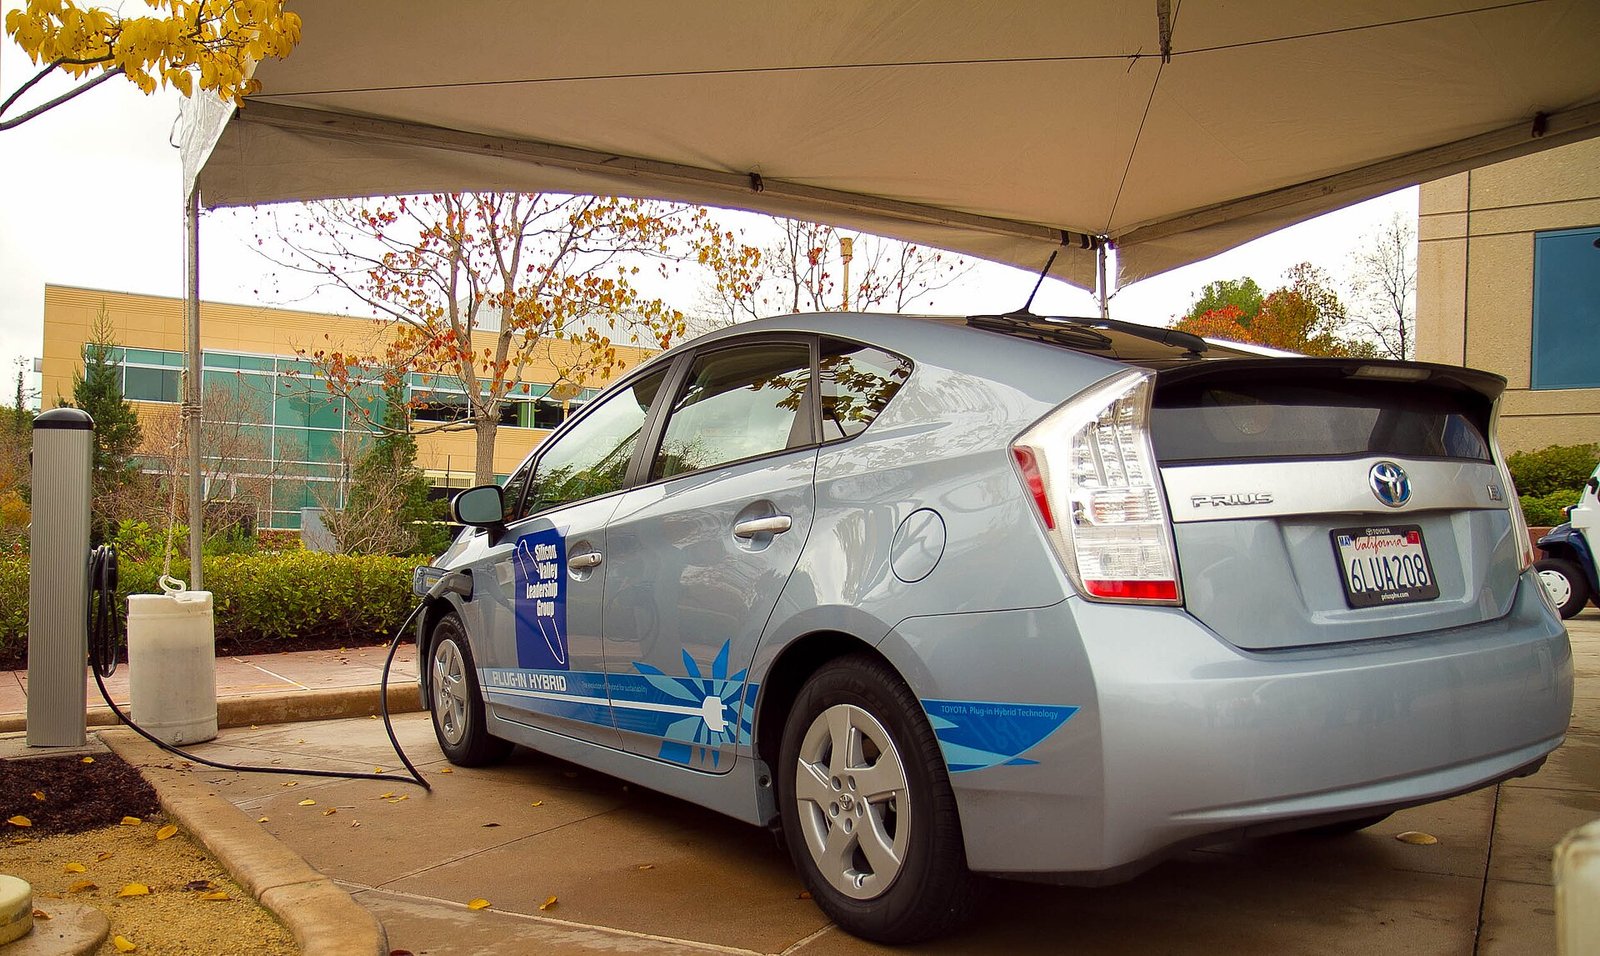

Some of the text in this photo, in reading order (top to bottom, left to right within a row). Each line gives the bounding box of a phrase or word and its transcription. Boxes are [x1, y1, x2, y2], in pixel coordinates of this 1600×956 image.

[1191, 493, 1274, 508] PRIUS
[534, 543, 557, 562] Silicon
[1354, 536, 1408, 554] California
[538, 562, 558, 580] Valley
[1351, 553, 1428, 592] 6LUA208
[526, 580, 558, 600] Leadership
[536, 600, 555, 618] Group
[493, 671, 567, 692] PLUG-IN HYBRID
[941, 705, 1059, 720] TOYOTA Plug-in Hybrid Technology
